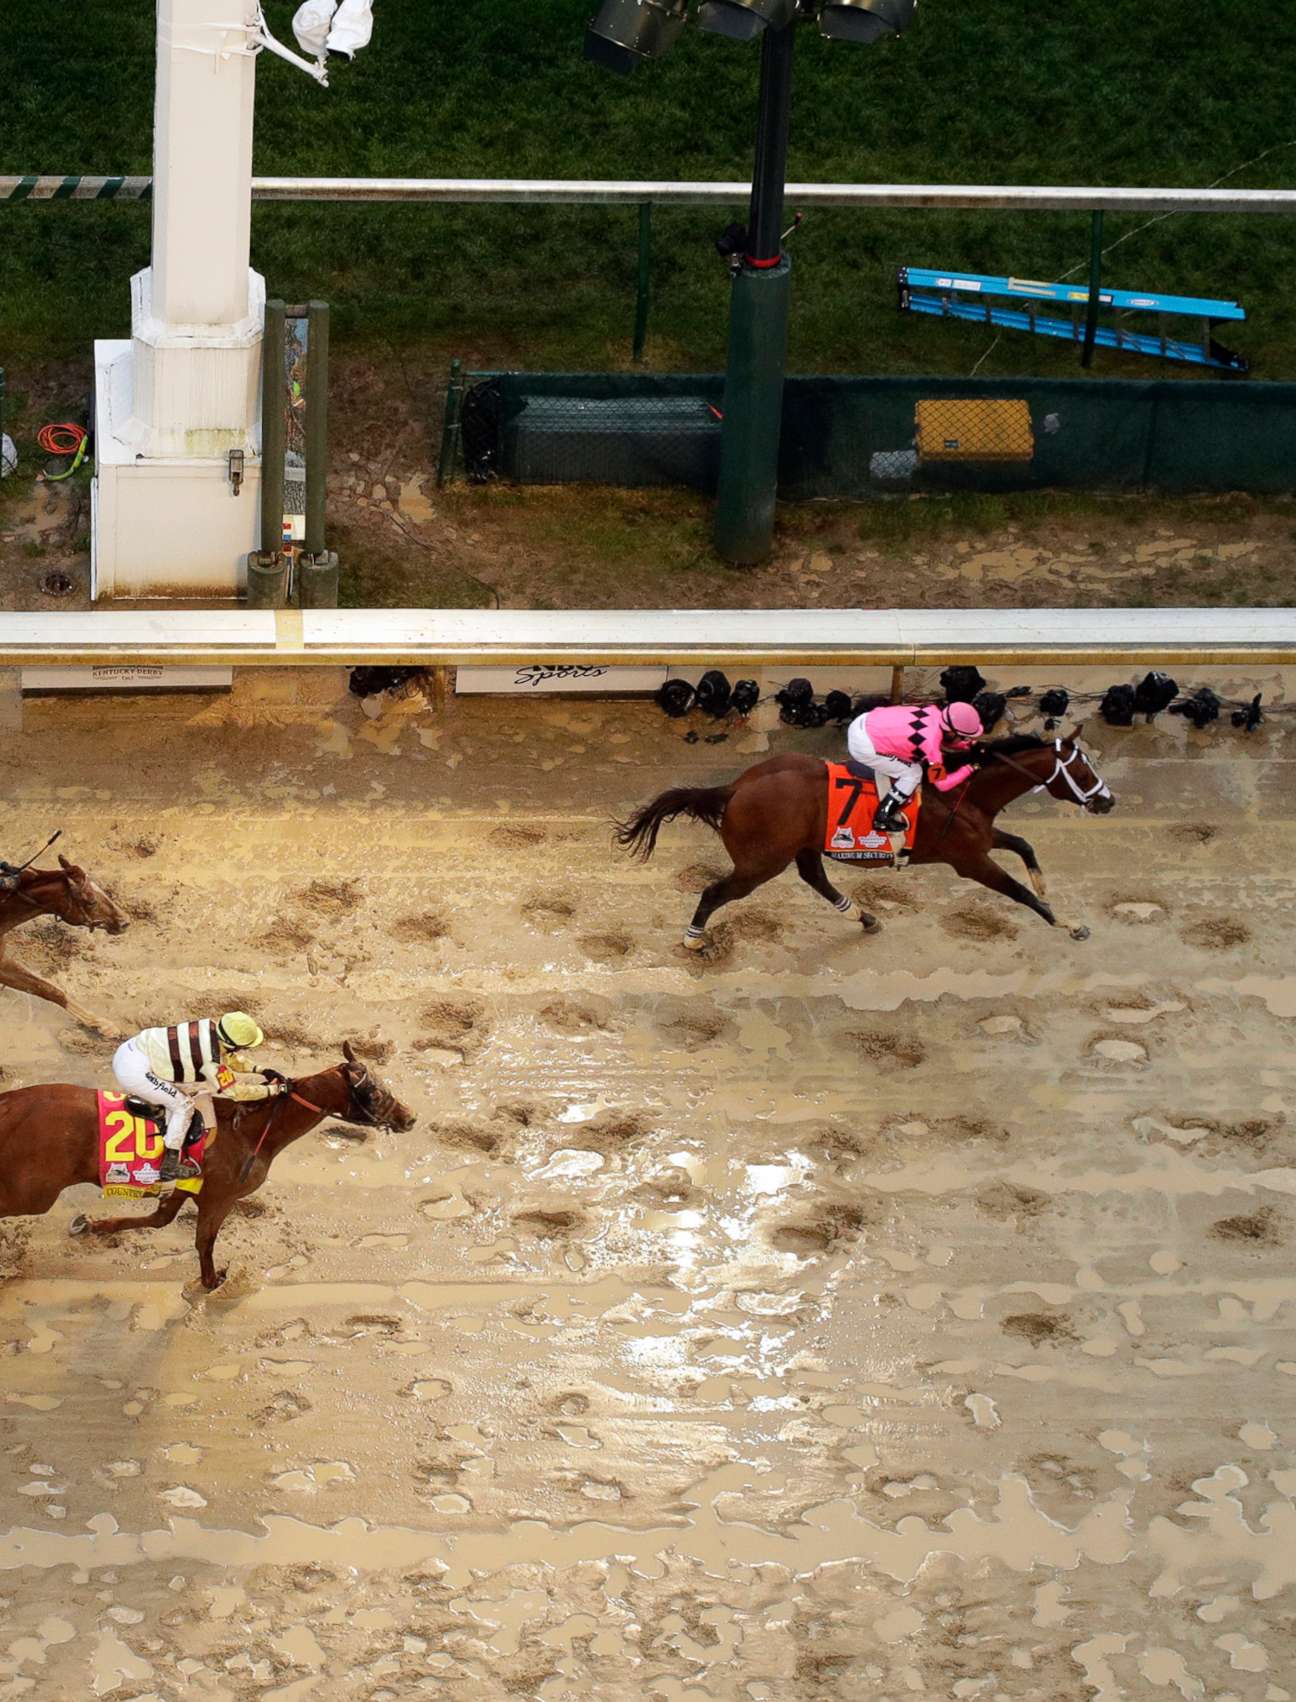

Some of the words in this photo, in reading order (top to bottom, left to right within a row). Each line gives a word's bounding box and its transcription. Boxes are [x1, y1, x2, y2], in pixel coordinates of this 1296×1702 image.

[514, 665, 609, 687] Sports
[933, 768, 942, 779] 7
[836, 778, 863, 825] 7
[217, 1072, 234, 1087] 20
[105, 1110, 164, 1162] 20
